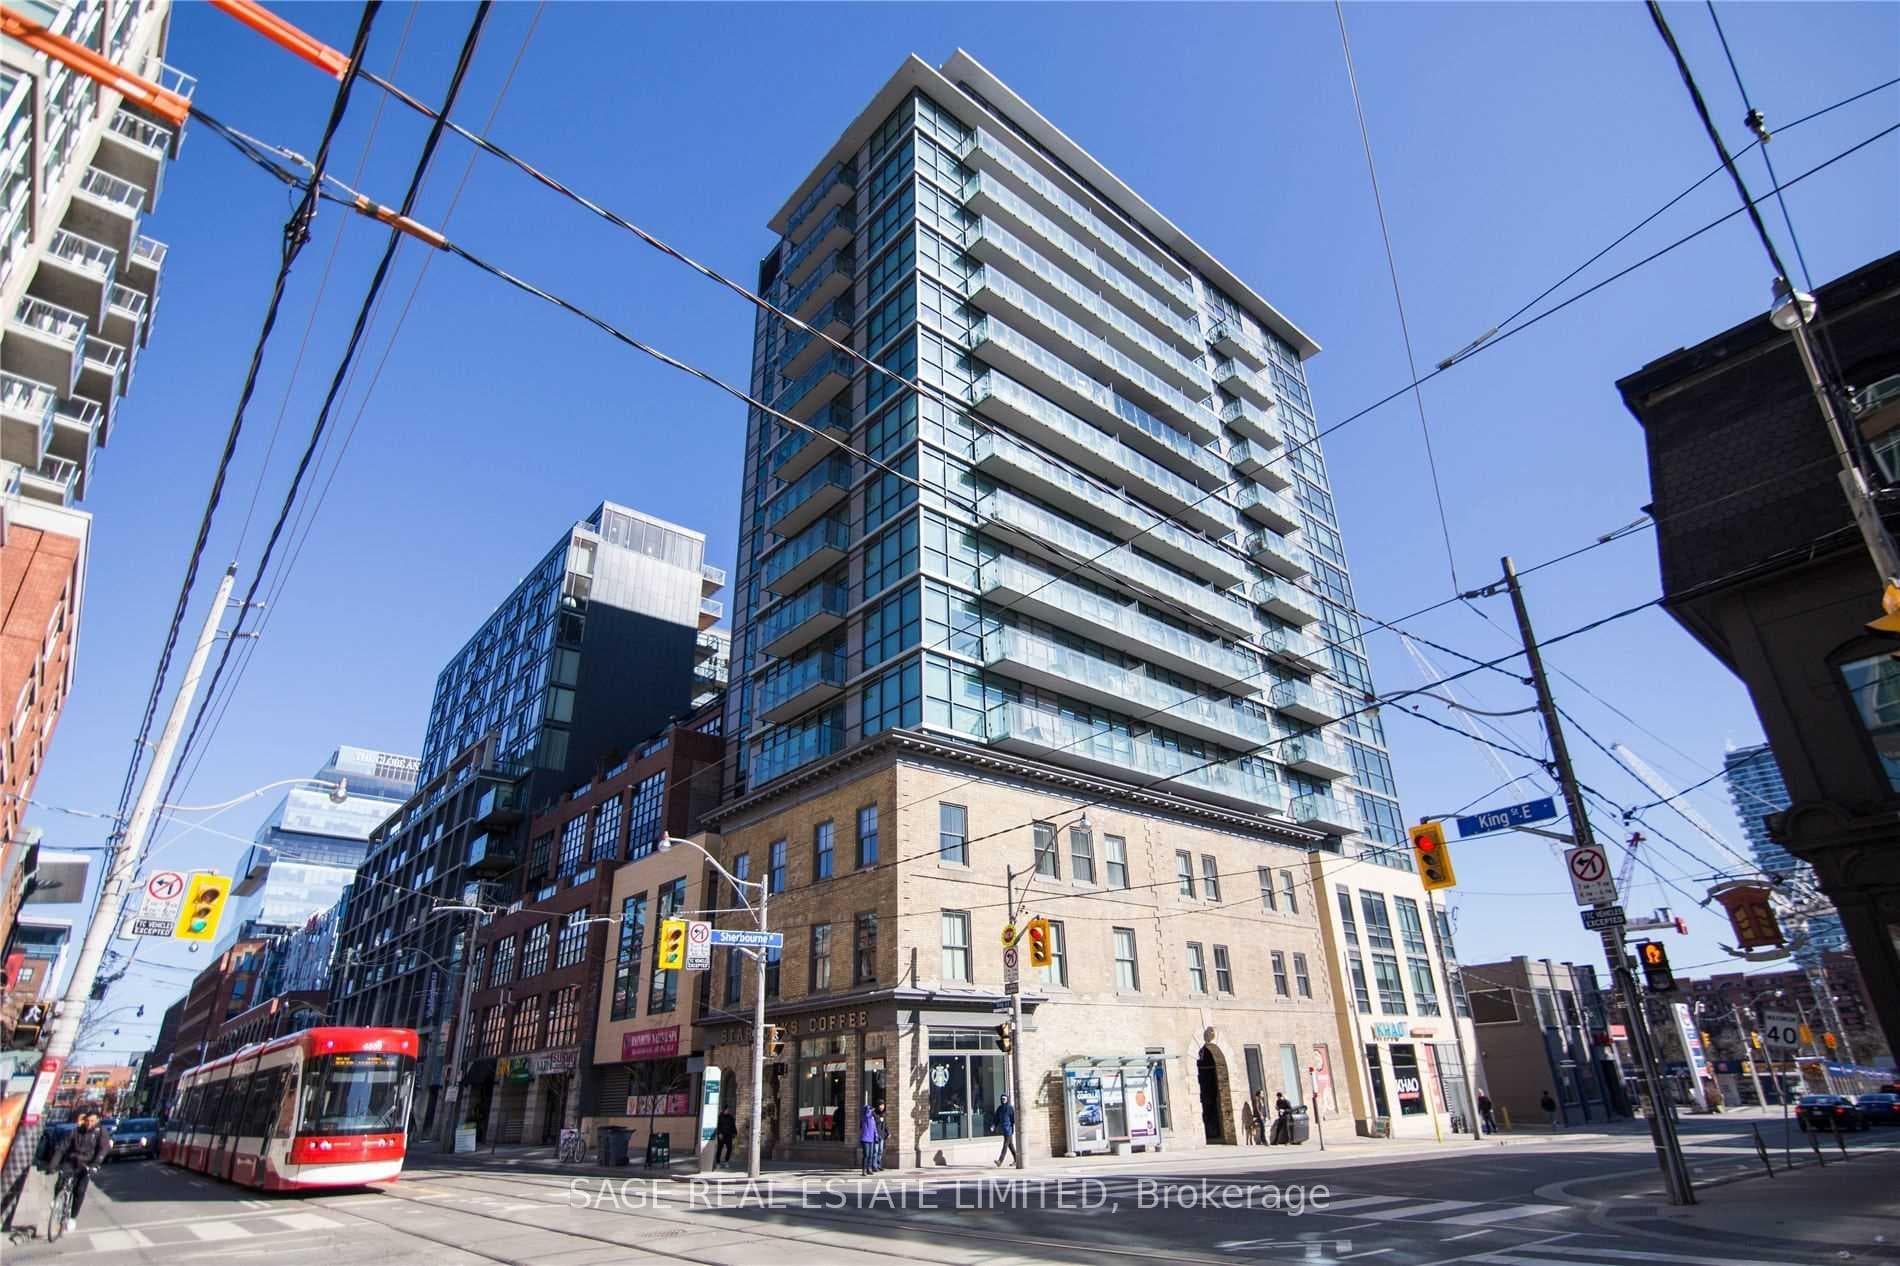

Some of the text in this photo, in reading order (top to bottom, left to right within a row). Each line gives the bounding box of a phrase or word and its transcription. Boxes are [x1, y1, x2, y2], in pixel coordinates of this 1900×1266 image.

[1478, 805, 1532, 828] King St E
[1586, 916, 1624, 928] EXCEPTED
[134, 927, 171, 936] EXCEPTED
[720, 931, 768, 944] Sherbourne
[809, 1010, 868, 1032] COFFEE
[1767, 1026, 1796, 1044] 40
[1396, 1078, 1420, 1093] KHAO
